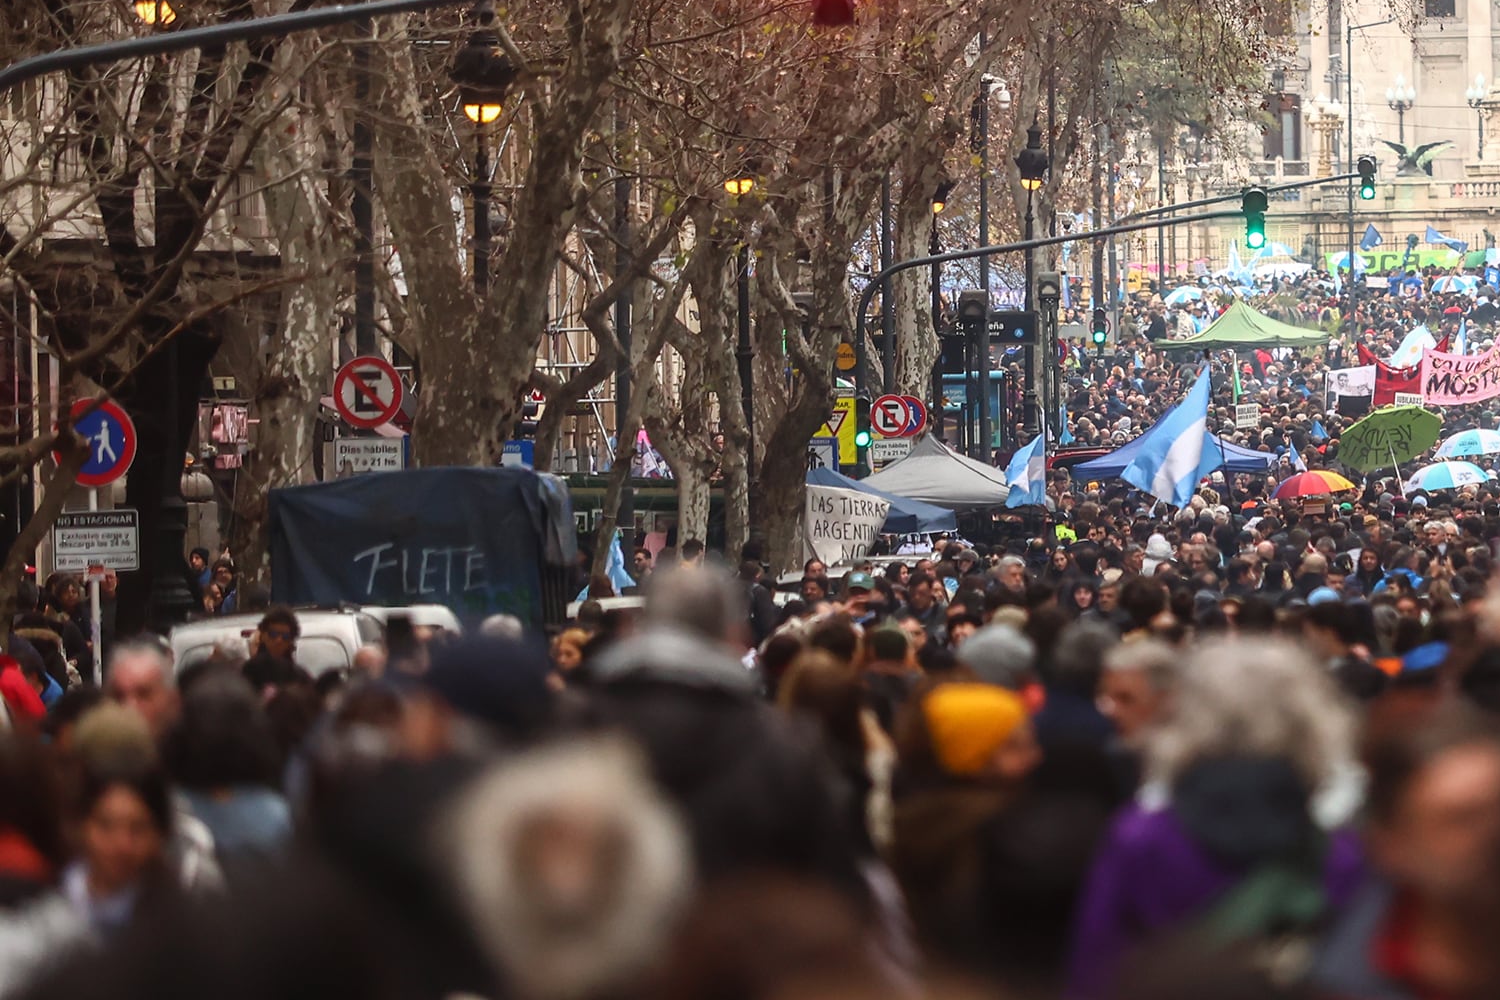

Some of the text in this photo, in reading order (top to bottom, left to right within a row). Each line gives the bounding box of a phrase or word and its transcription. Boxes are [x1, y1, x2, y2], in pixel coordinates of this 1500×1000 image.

[370, 456, 382, 466] 21
[811, 495, 887, 519] LAS TIERRAS
[57, 517, 71, 527] NO
[841, 543, 868, 561] NO
[353, 542, 486, 595] FLETE
